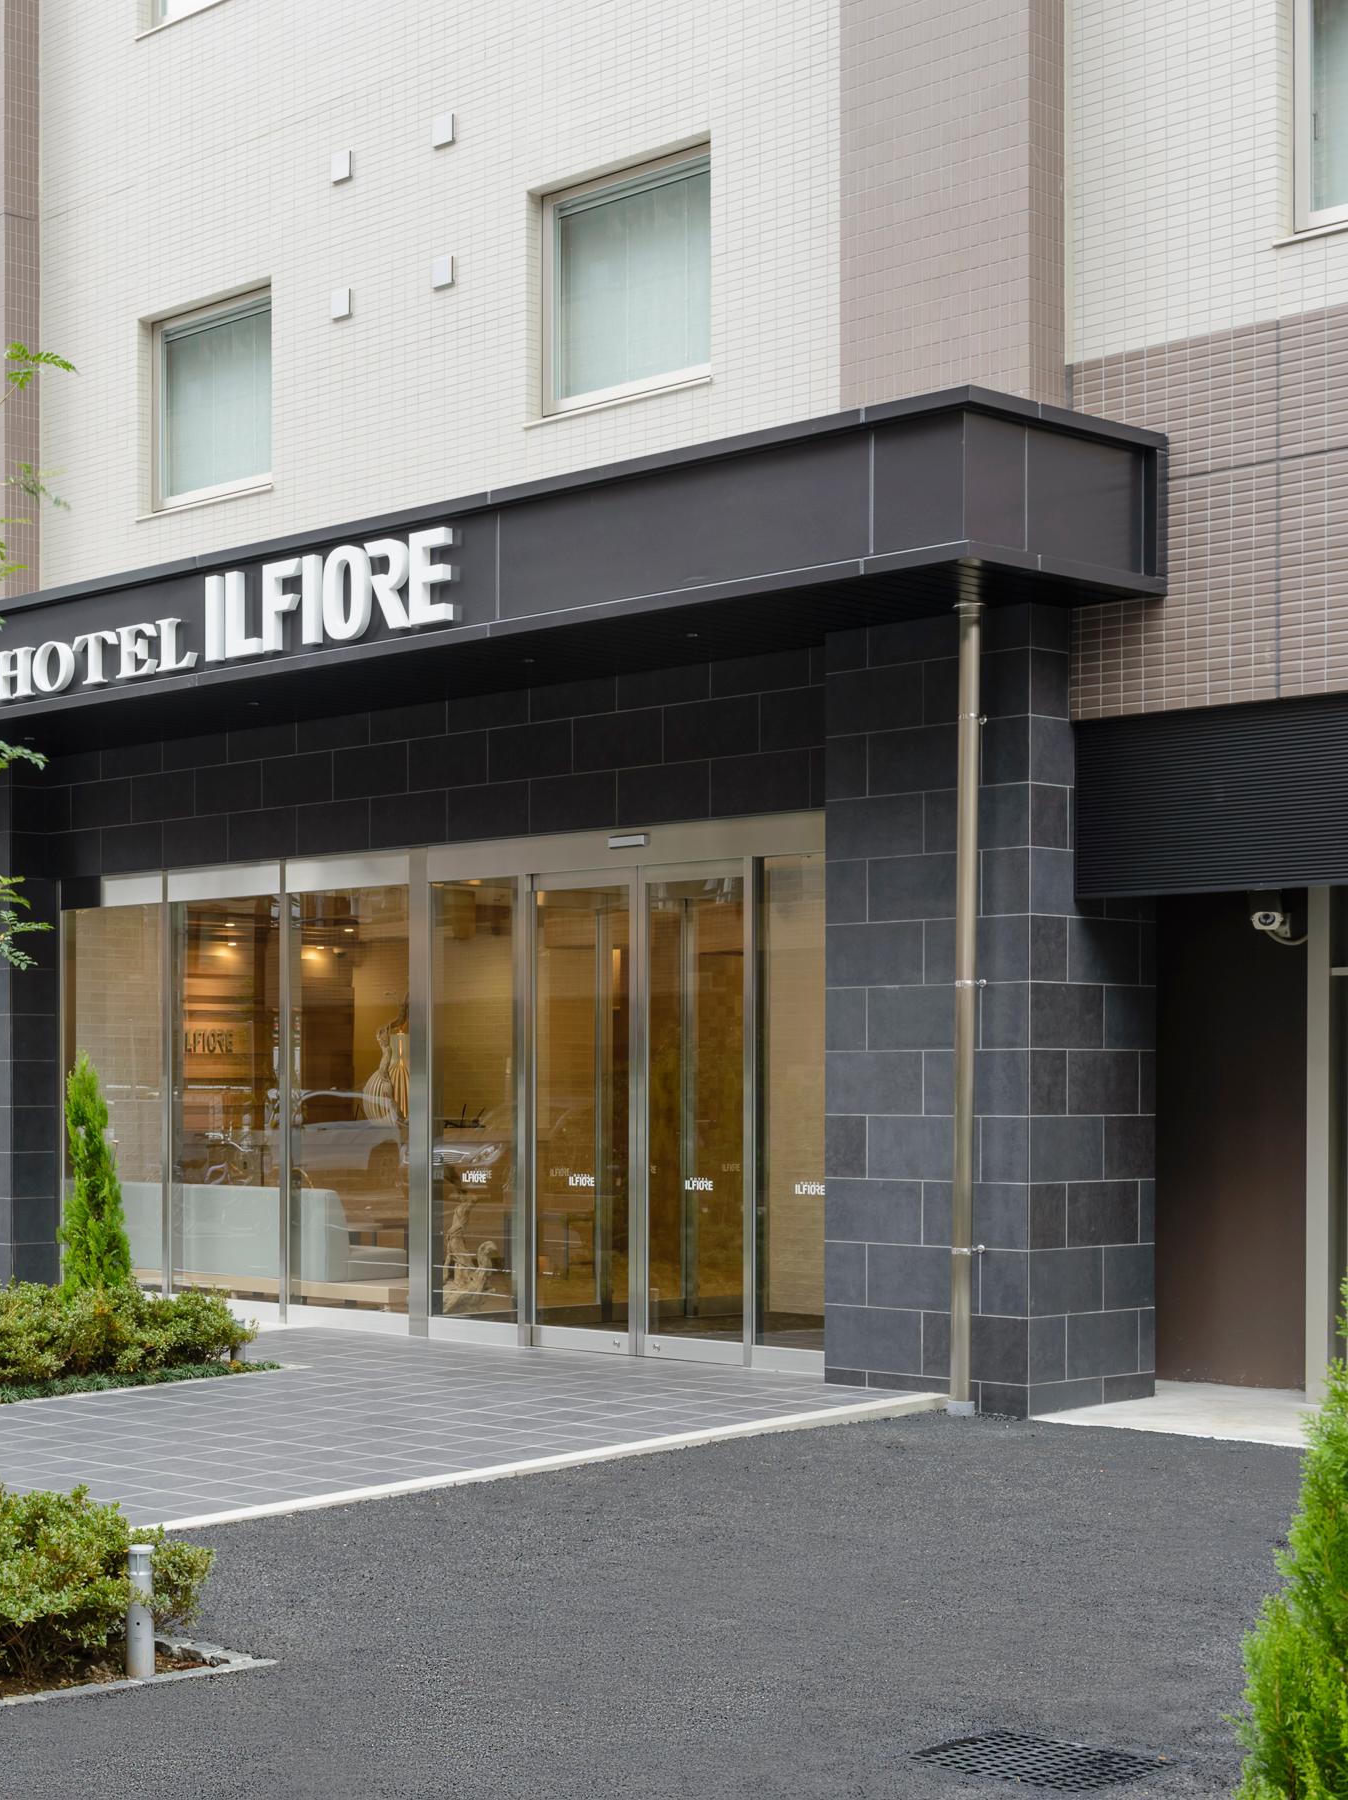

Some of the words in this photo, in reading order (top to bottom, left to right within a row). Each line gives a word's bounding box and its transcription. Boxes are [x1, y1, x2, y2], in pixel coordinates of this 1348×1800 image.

[205, 526, 454, 663] ILFIORE
[184, 1030, 233, 1053] LFIORE
[568, 1176, 595, 1187] ILFIORE
[685, 1180, 713, 1190] ILFIORE
[795, 1184, 826, 1195] ILFIORE
